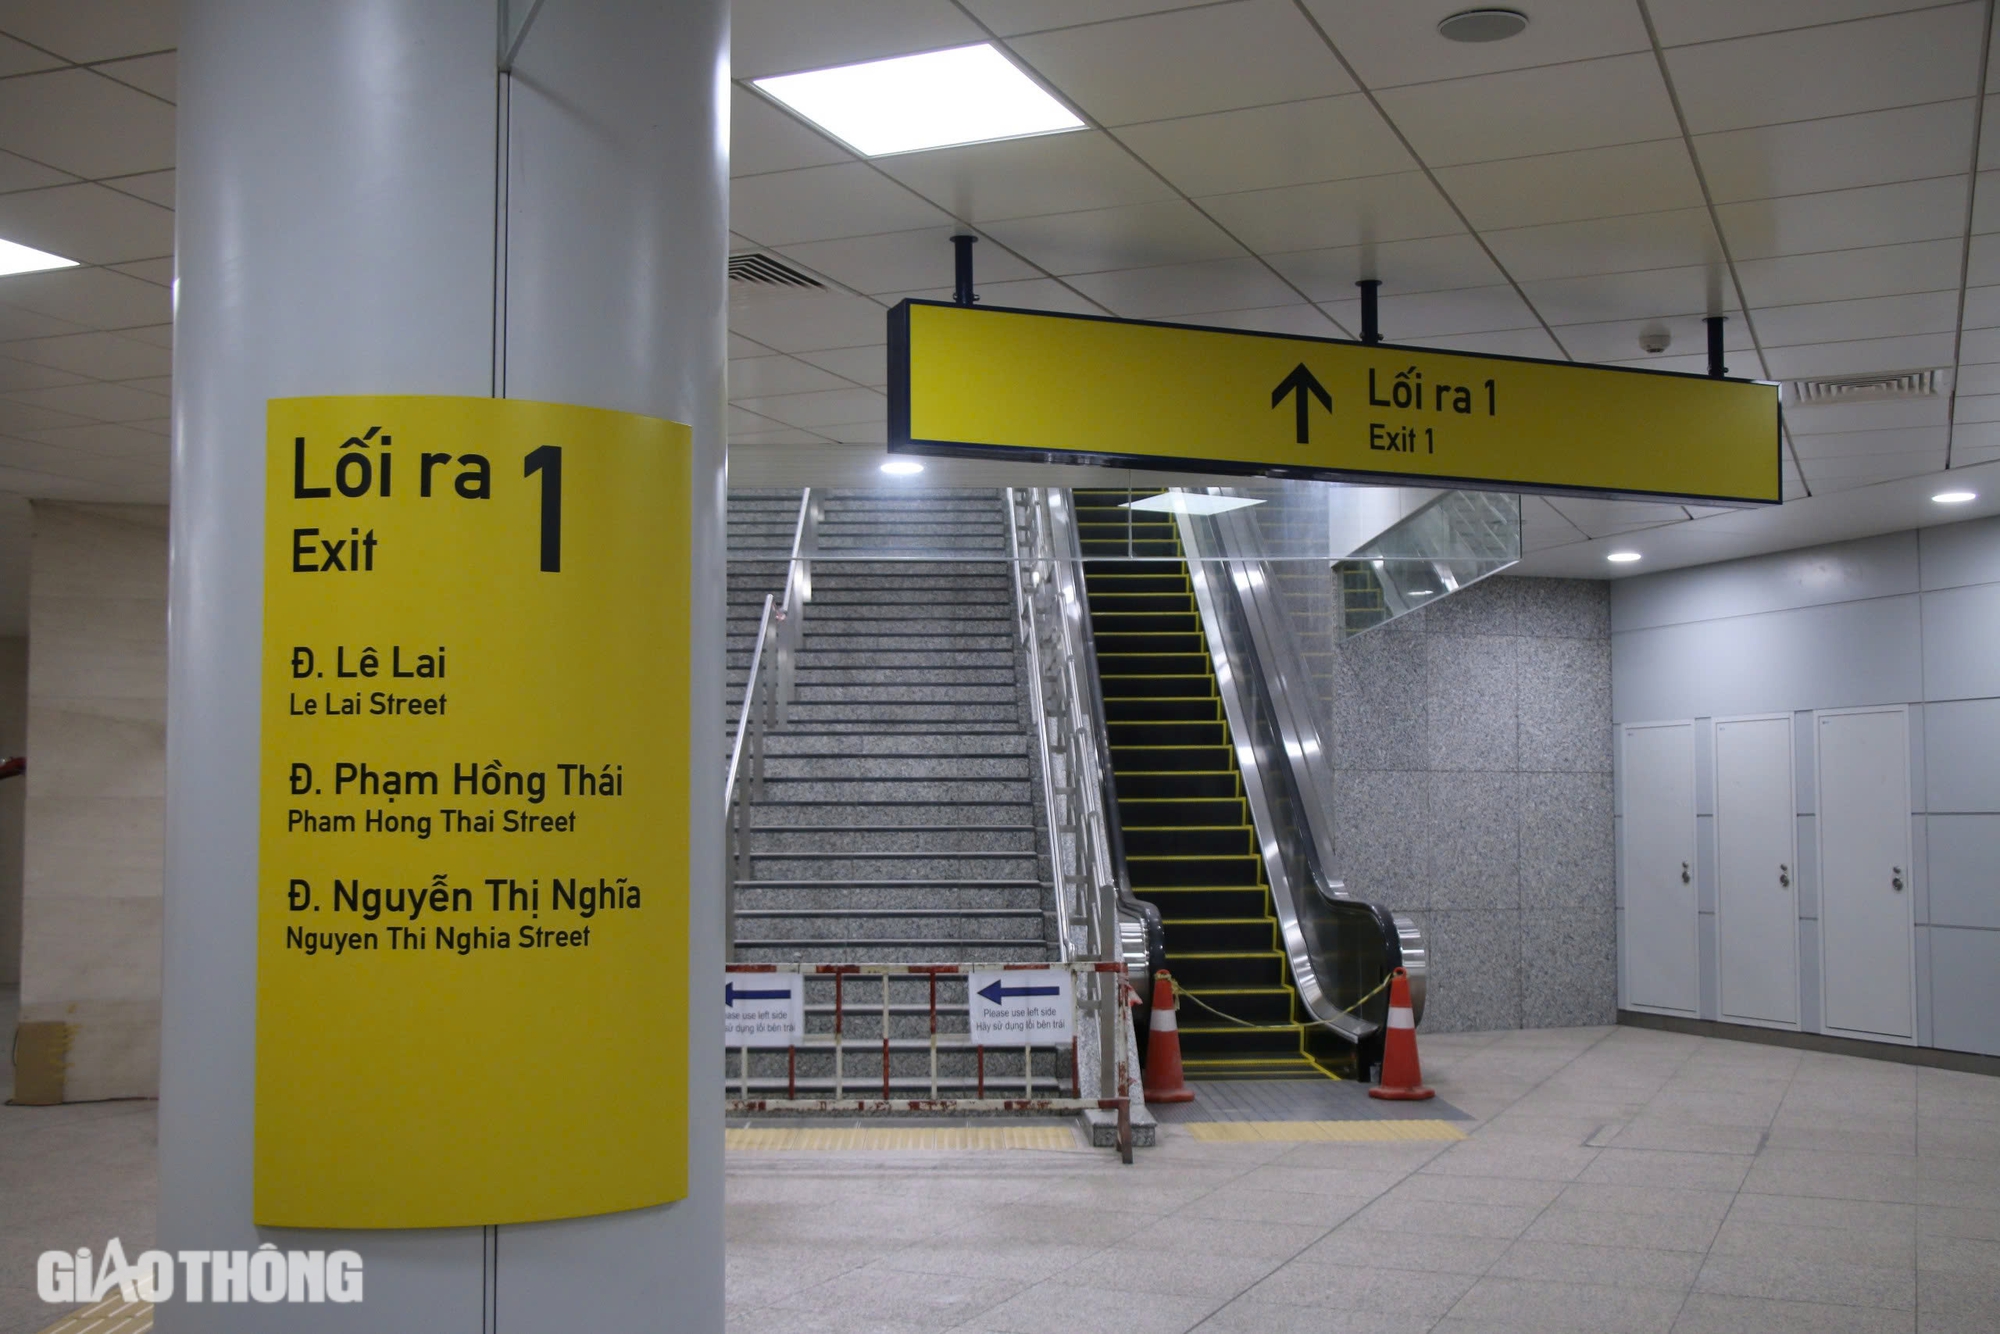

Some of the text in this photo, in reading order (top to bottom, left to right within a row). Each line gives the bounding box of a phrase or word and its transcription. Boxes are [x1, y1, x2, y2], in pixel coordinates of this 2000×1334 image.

[1368, 366, 1496, 416] Lối ra 1
[1369, 423, 1434, 454] Exit 1
[294, 426, 562, 573] Lối ra 1
[292, 528, 378, 572] Exit
[291, 646, 446, 679] Đ. Lê Lai
[289, 692, 448, 716] Le Lai Street
[290, 759, 624, 804] Đ. Phạm Hồng Thái
[288, 810, 576, 840] Pham Hong Thai Street
[288, 873, 642, 921] Đ. Nguyễn Thị Nghĩa
[286, 924, 591, 955] Nguyen Thi Nghia Street
[725, 1010, 787, 1020] ase use left side
[984, 1006, 1056, 1018] Please use left side
